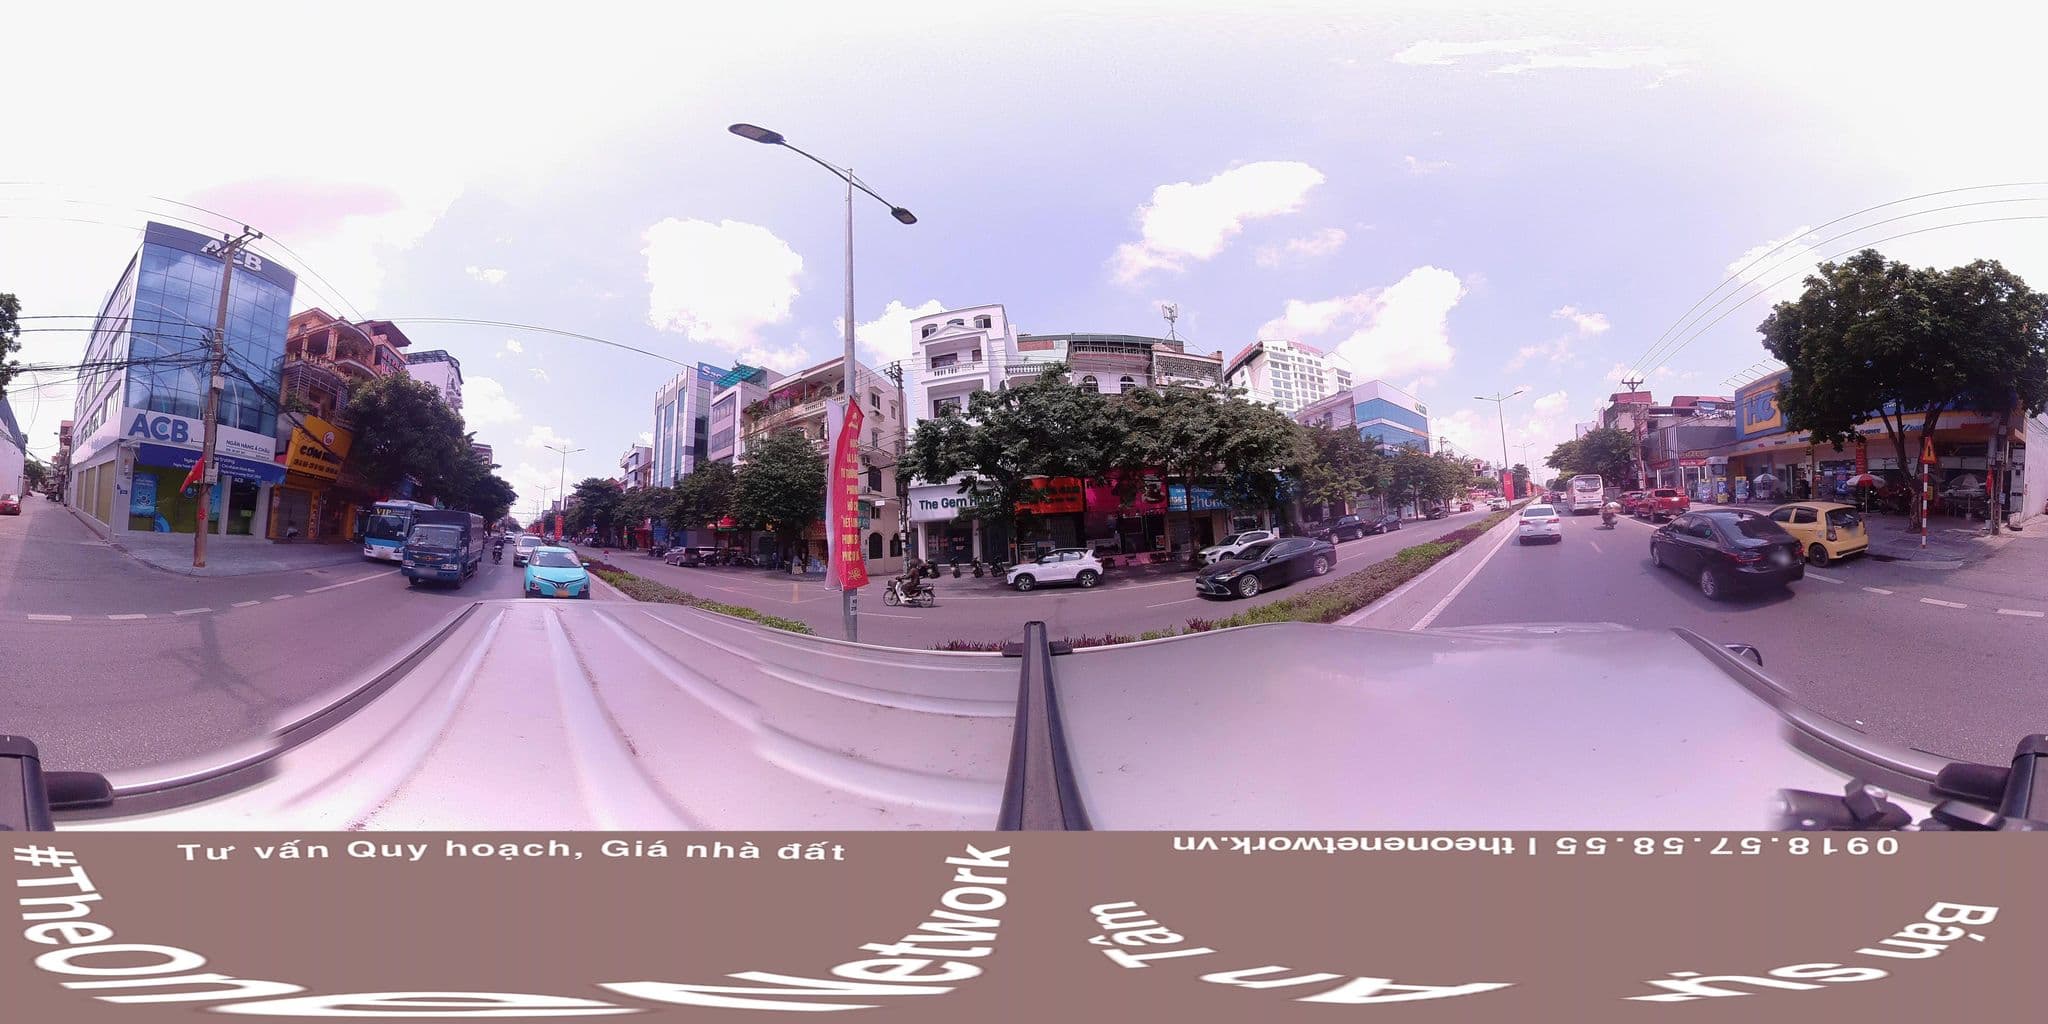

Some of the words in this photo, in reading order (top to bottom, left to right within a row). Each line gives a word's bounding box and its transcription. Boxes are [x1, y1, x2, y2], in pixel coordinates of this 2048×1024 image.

[128, 413, 189, 443] ACB
[918, 500, 938, 511] The
[941, 497, 967, 508] Gem
[376, 508, 391, 516] VIP
